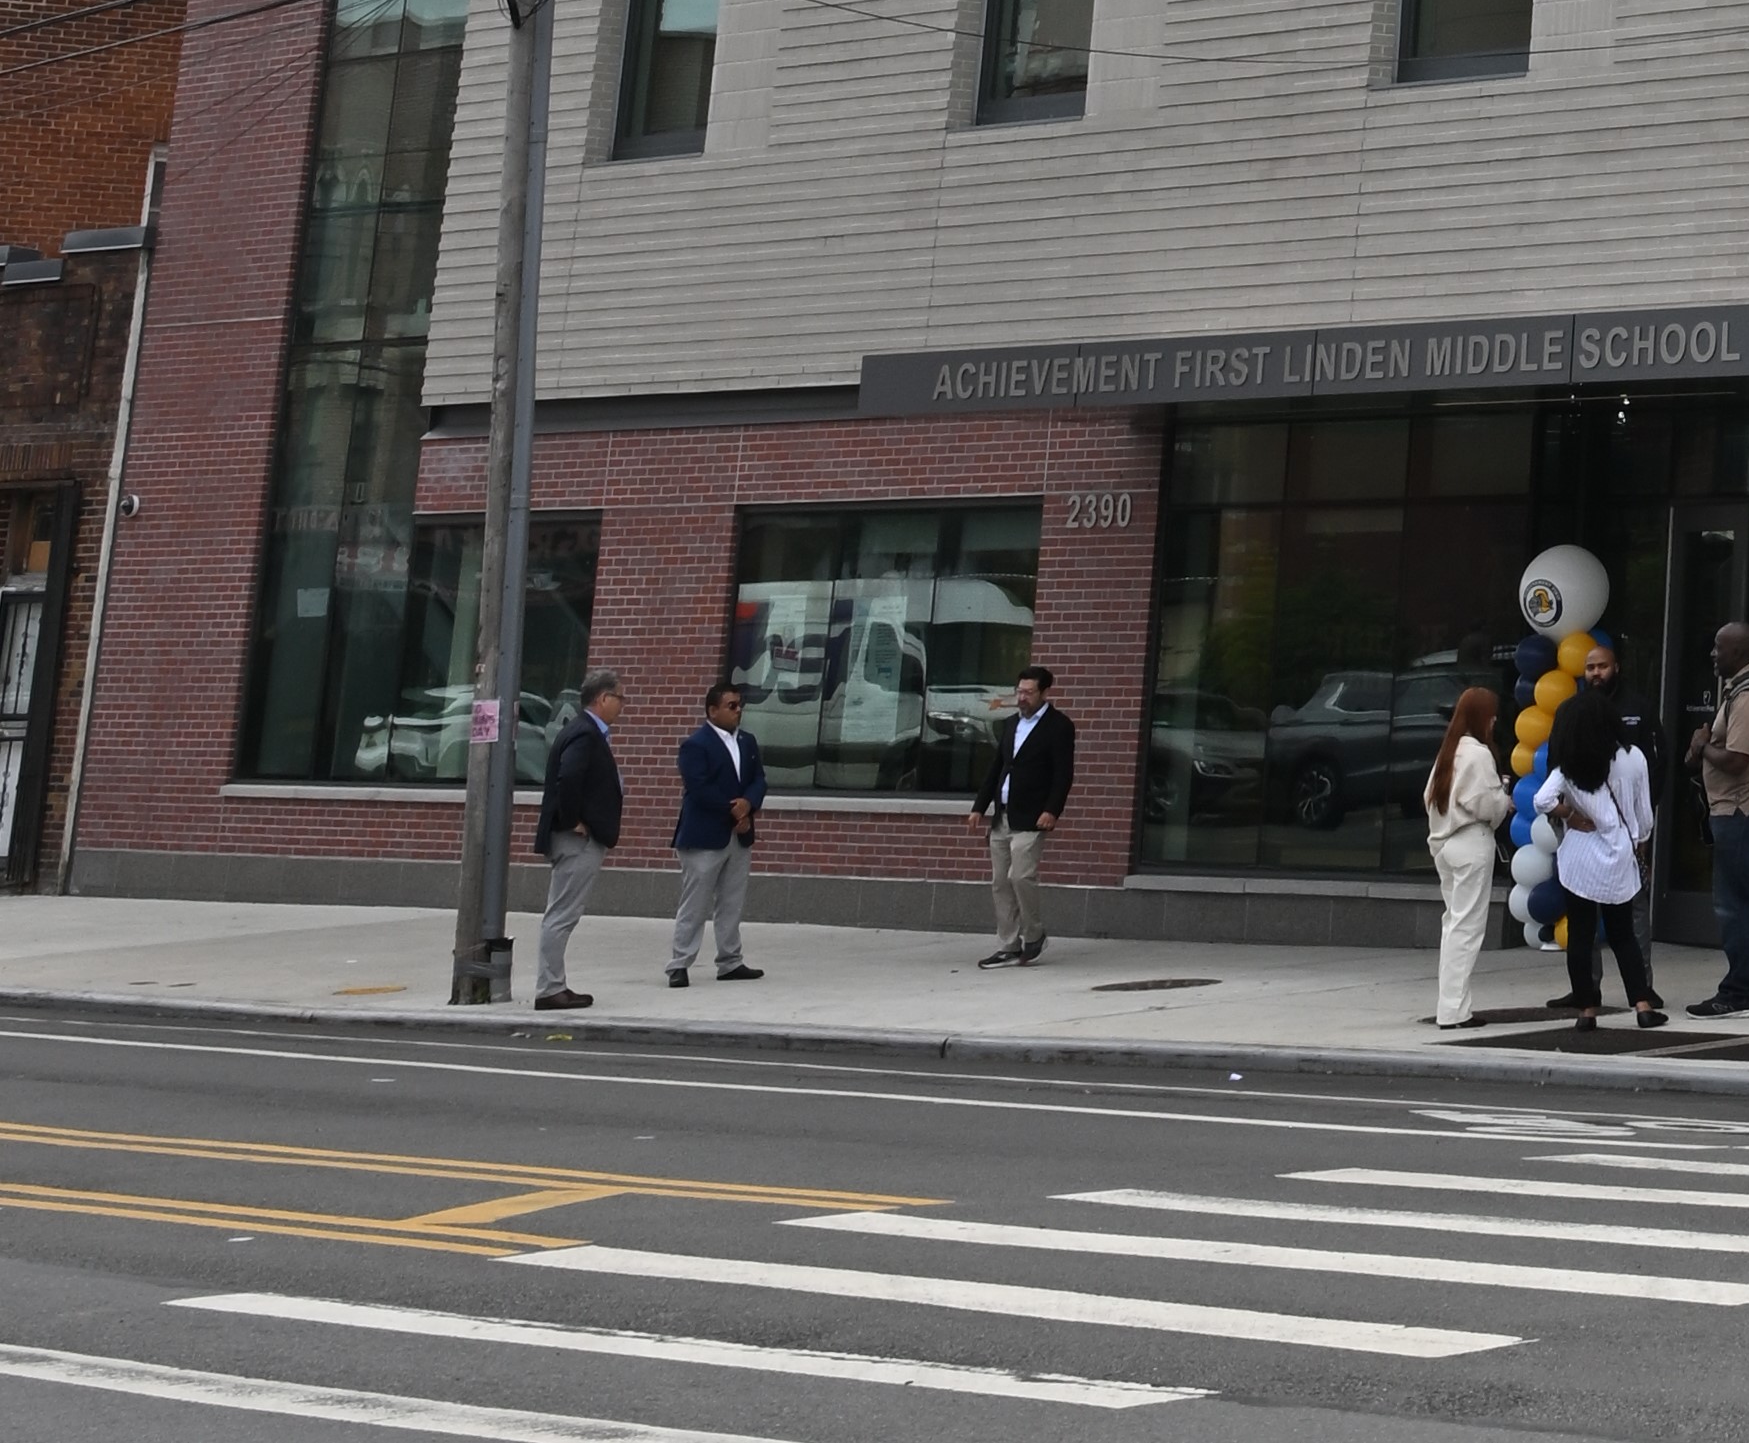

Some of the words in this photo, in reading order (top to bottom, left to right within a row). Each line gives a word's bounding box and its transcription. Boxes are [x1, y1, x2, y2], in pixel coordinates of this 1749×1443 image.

[932, 351, 1164, 401] ACHIEVEMENT
[1173, 345, 1272, 389] FIRST
[1282, 338, 1413, 384] LINDEN
[1425, 329, 1565, 377] MIDDLE
[1577, 320, 1742, 370] SCHOOL
[1065, 493, 1131, 529] 2390
